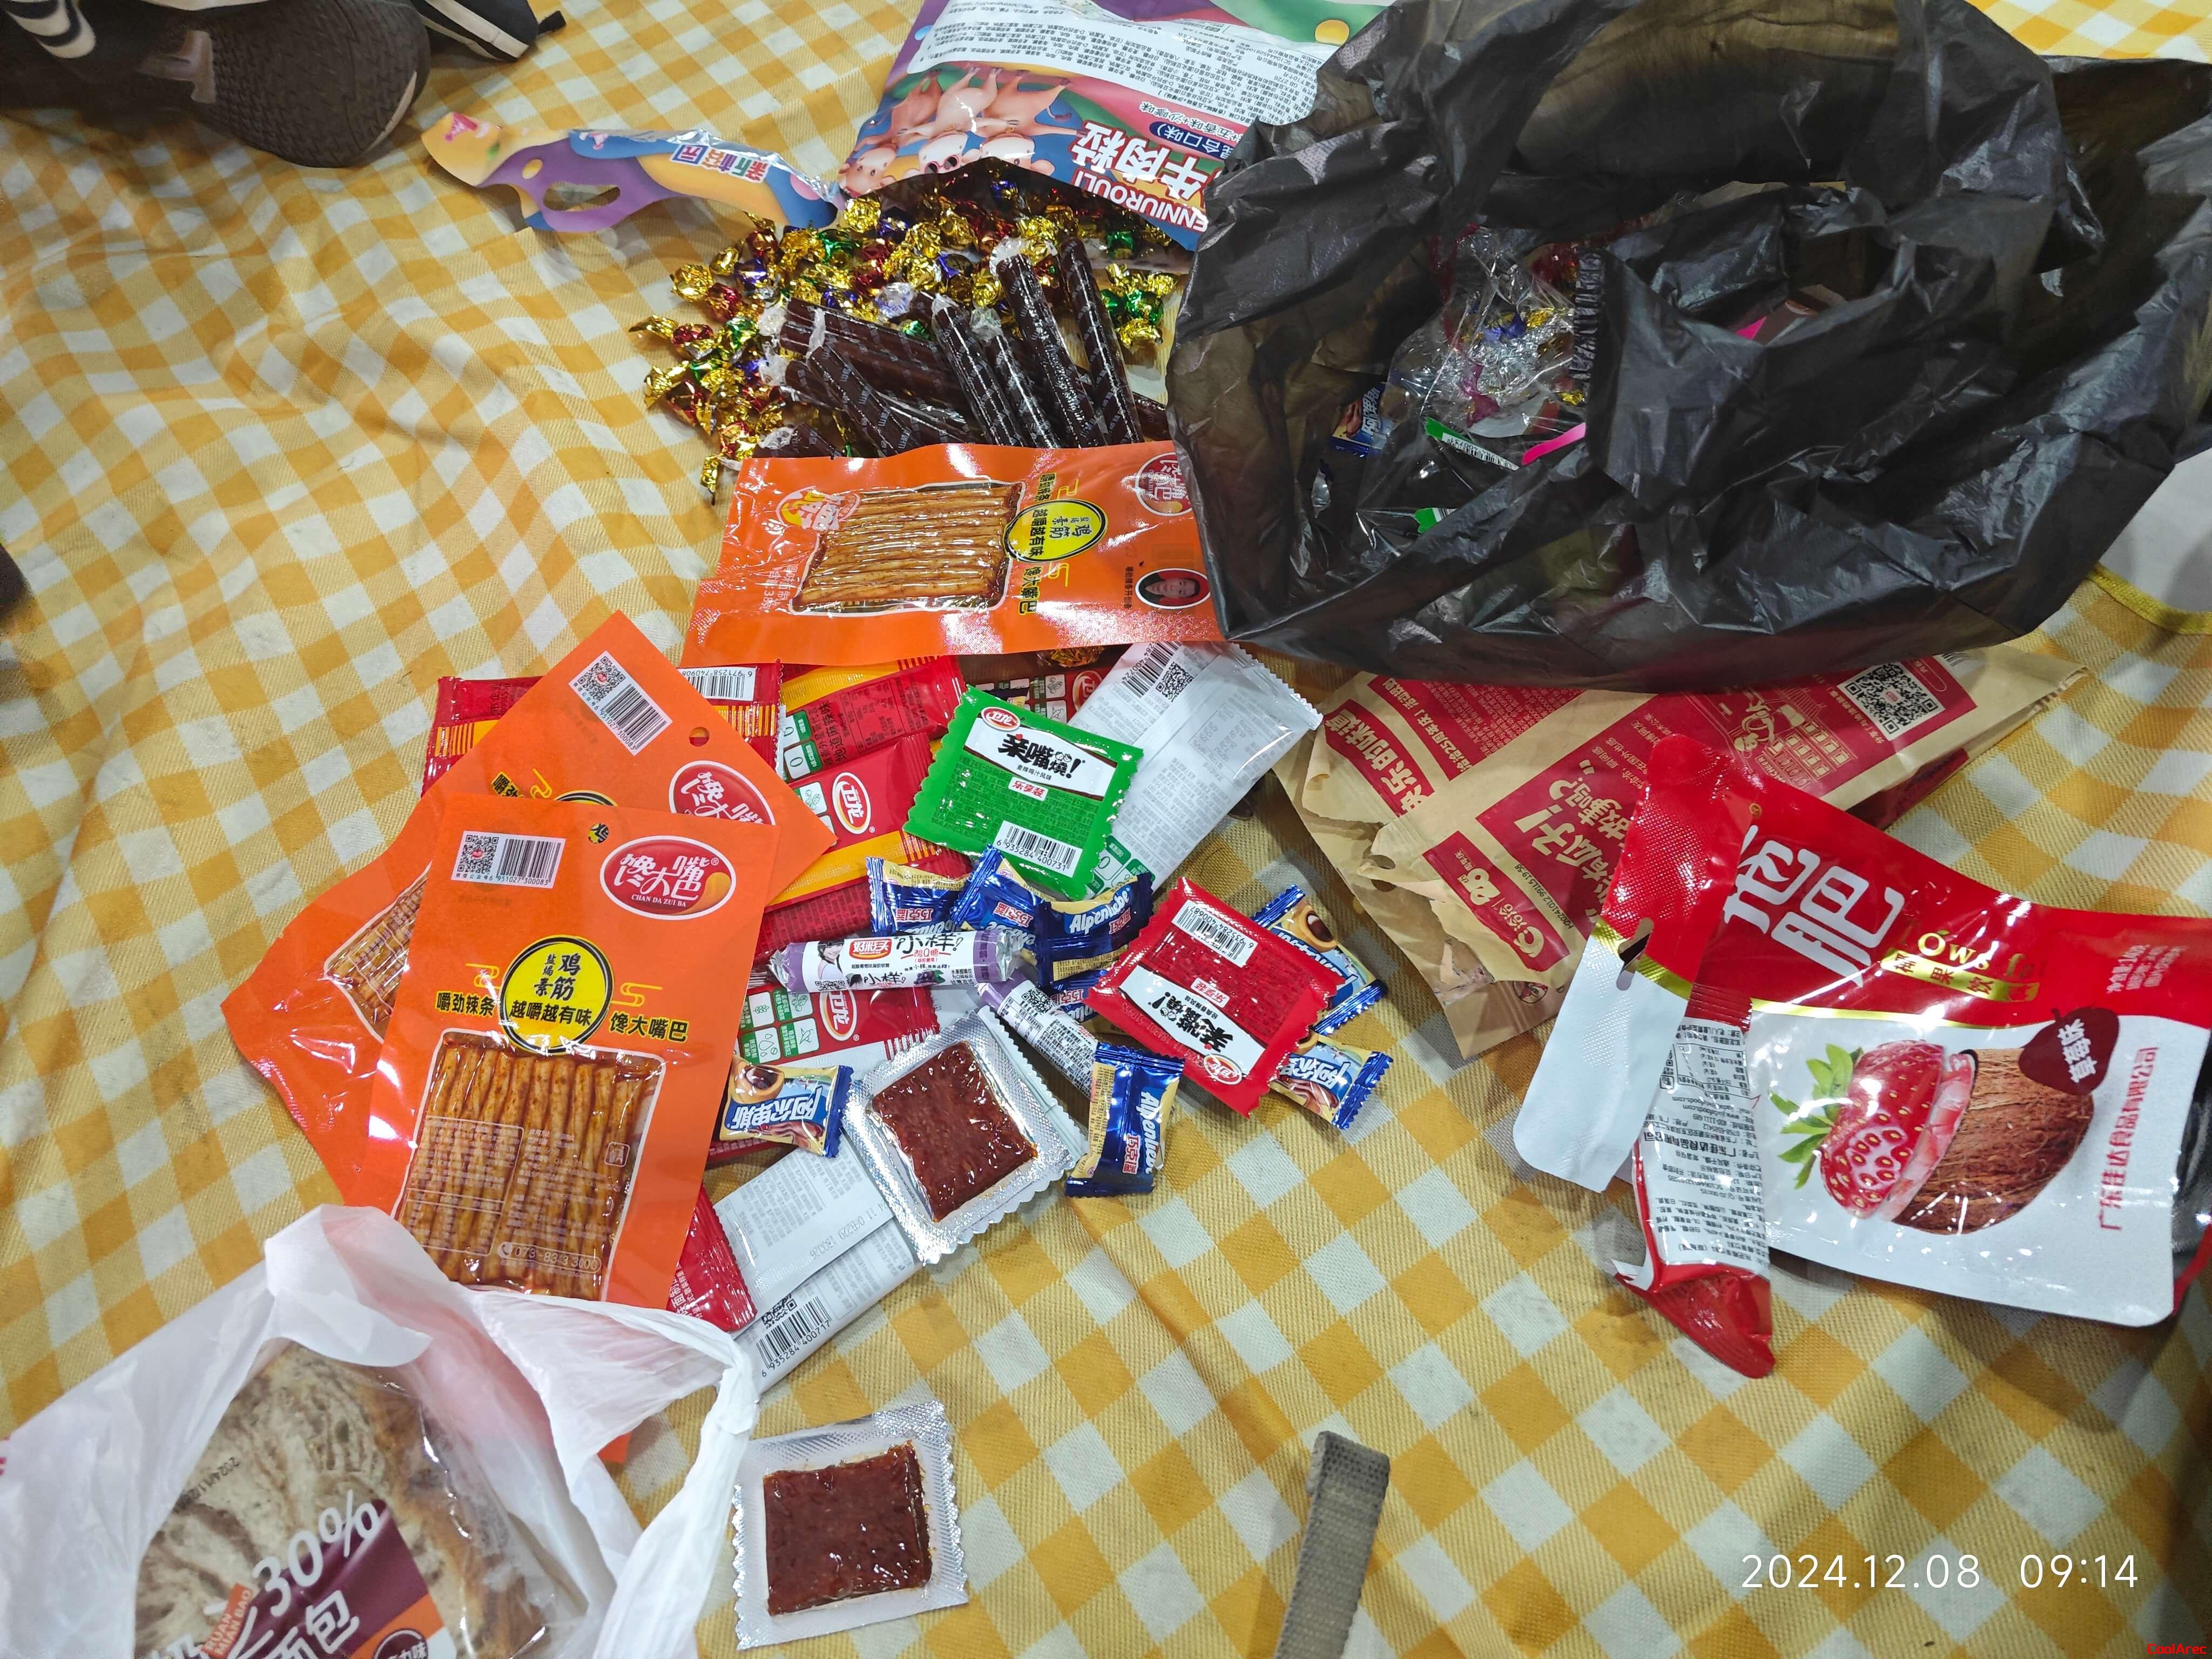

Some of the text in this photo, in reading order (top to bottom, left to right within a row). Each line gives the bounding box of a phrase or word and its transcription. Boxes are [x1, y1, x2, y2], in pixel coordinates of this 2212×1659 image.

[1071, 122, 1209, 200] 牛肉粒
[711, 669, 744, 679] 971258
[597, 708, 620, 733] 951027
[616, 729, 638, 753] 300083
[1011, 779, 1046, 799] 乐享装
[841, 781, 864, 829] 卫龙
[1003, 841, 1035, 859] 935284
[1036, 855, 1067, 872] 400731
[497, 875, 523, 885] 951027
[524, 877, 550, 887] 300083
[1514, 862, 1532, 881] 19:58
[631, 893, 651, 902] CHAN
[1069, 889, 1132, 934] Alpenliebe
[1188, 904, 1217, 927] 400687
[1496, 899, 1528, 933] 洽洽
[853, 939, 889, 955] 好彩头
[1217, 922, 1245, 945] 935284
[435, 992, 495, 1019] 嚼劲辣条
[509, 1000, 593, 1028] 越嚼越有味
[610, 1012, 689, 1043] 馋大嘴巴
[2057, 1019, 2097, 1083] 草莓味
[769, 1346, 800, 1370] 935284
[802, 1320, 831, 1346] 400717
